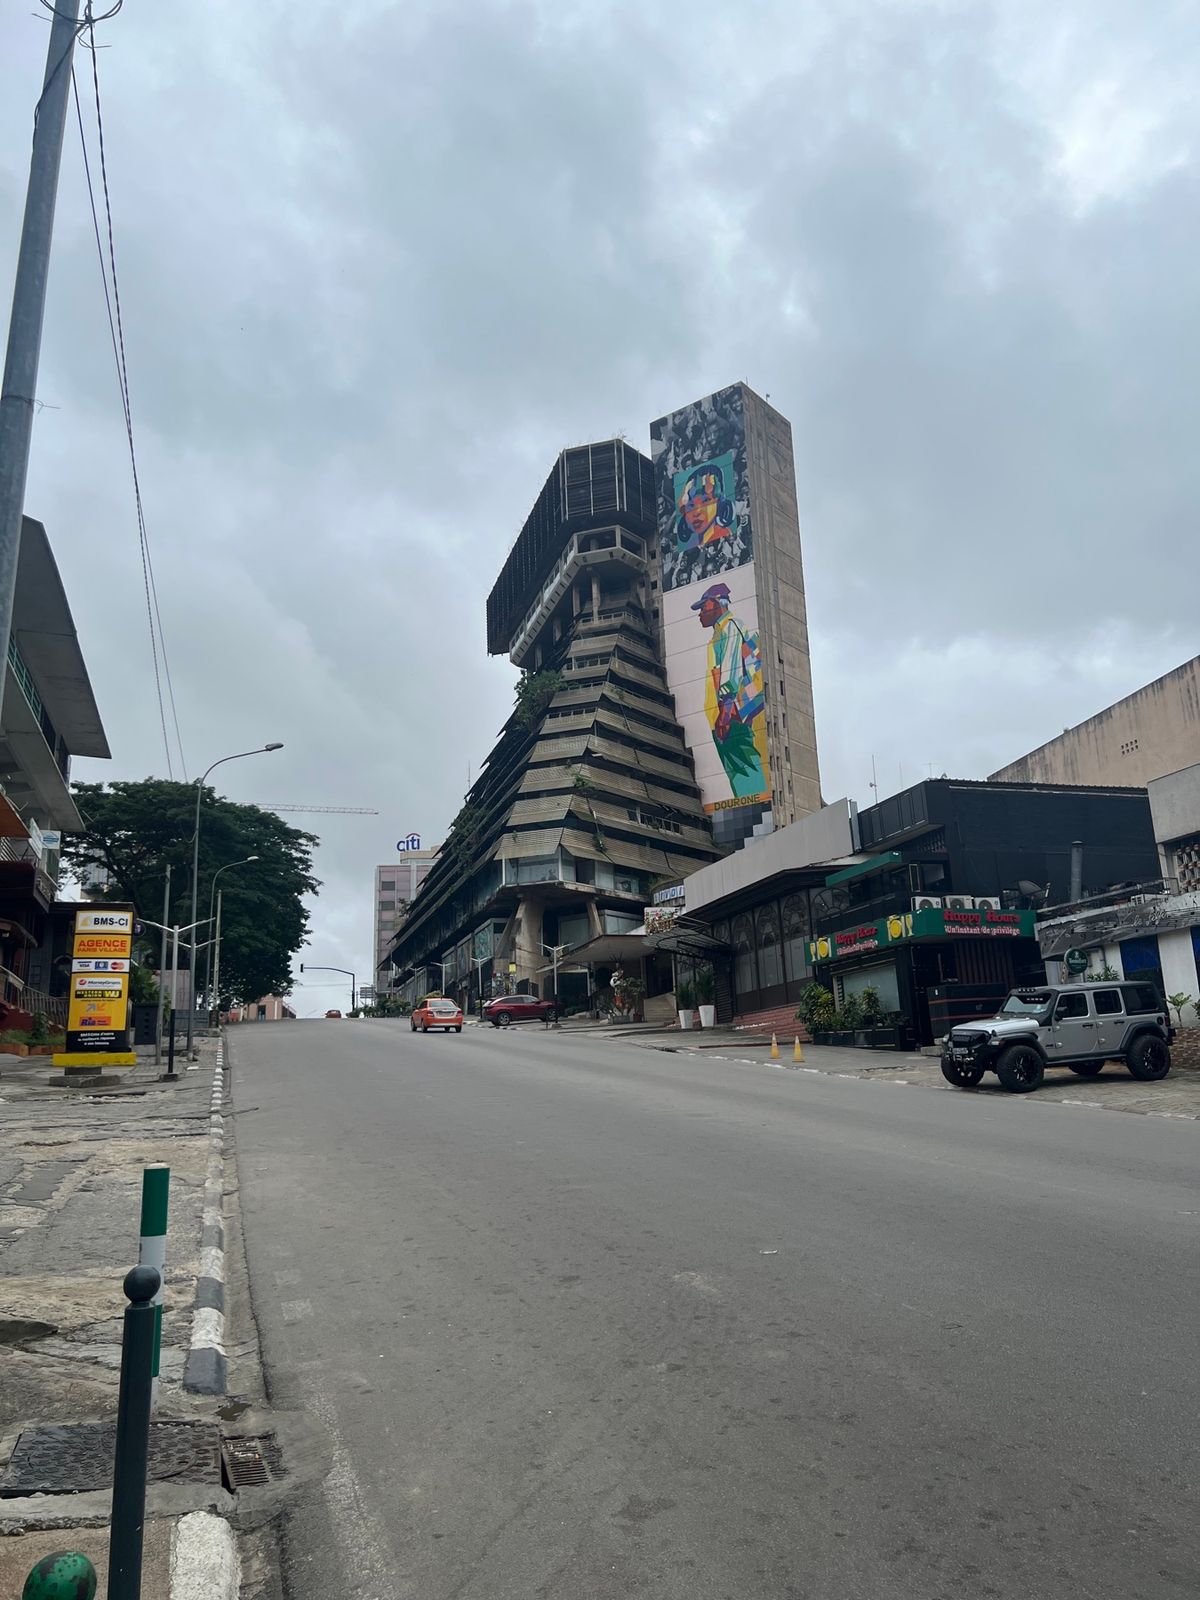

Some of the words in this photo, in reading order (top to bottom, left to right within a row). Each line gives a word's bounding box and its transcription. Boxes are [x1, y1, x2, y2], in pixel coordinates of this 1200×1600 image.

[714, 794, 760, 810] DOURONE
[396, 836, 420, 852] citi
[94, 917, 128, 926] BMS-CI
[944, 910, 981, 925] Happy
[986, 910, 1021, 923] Hours
